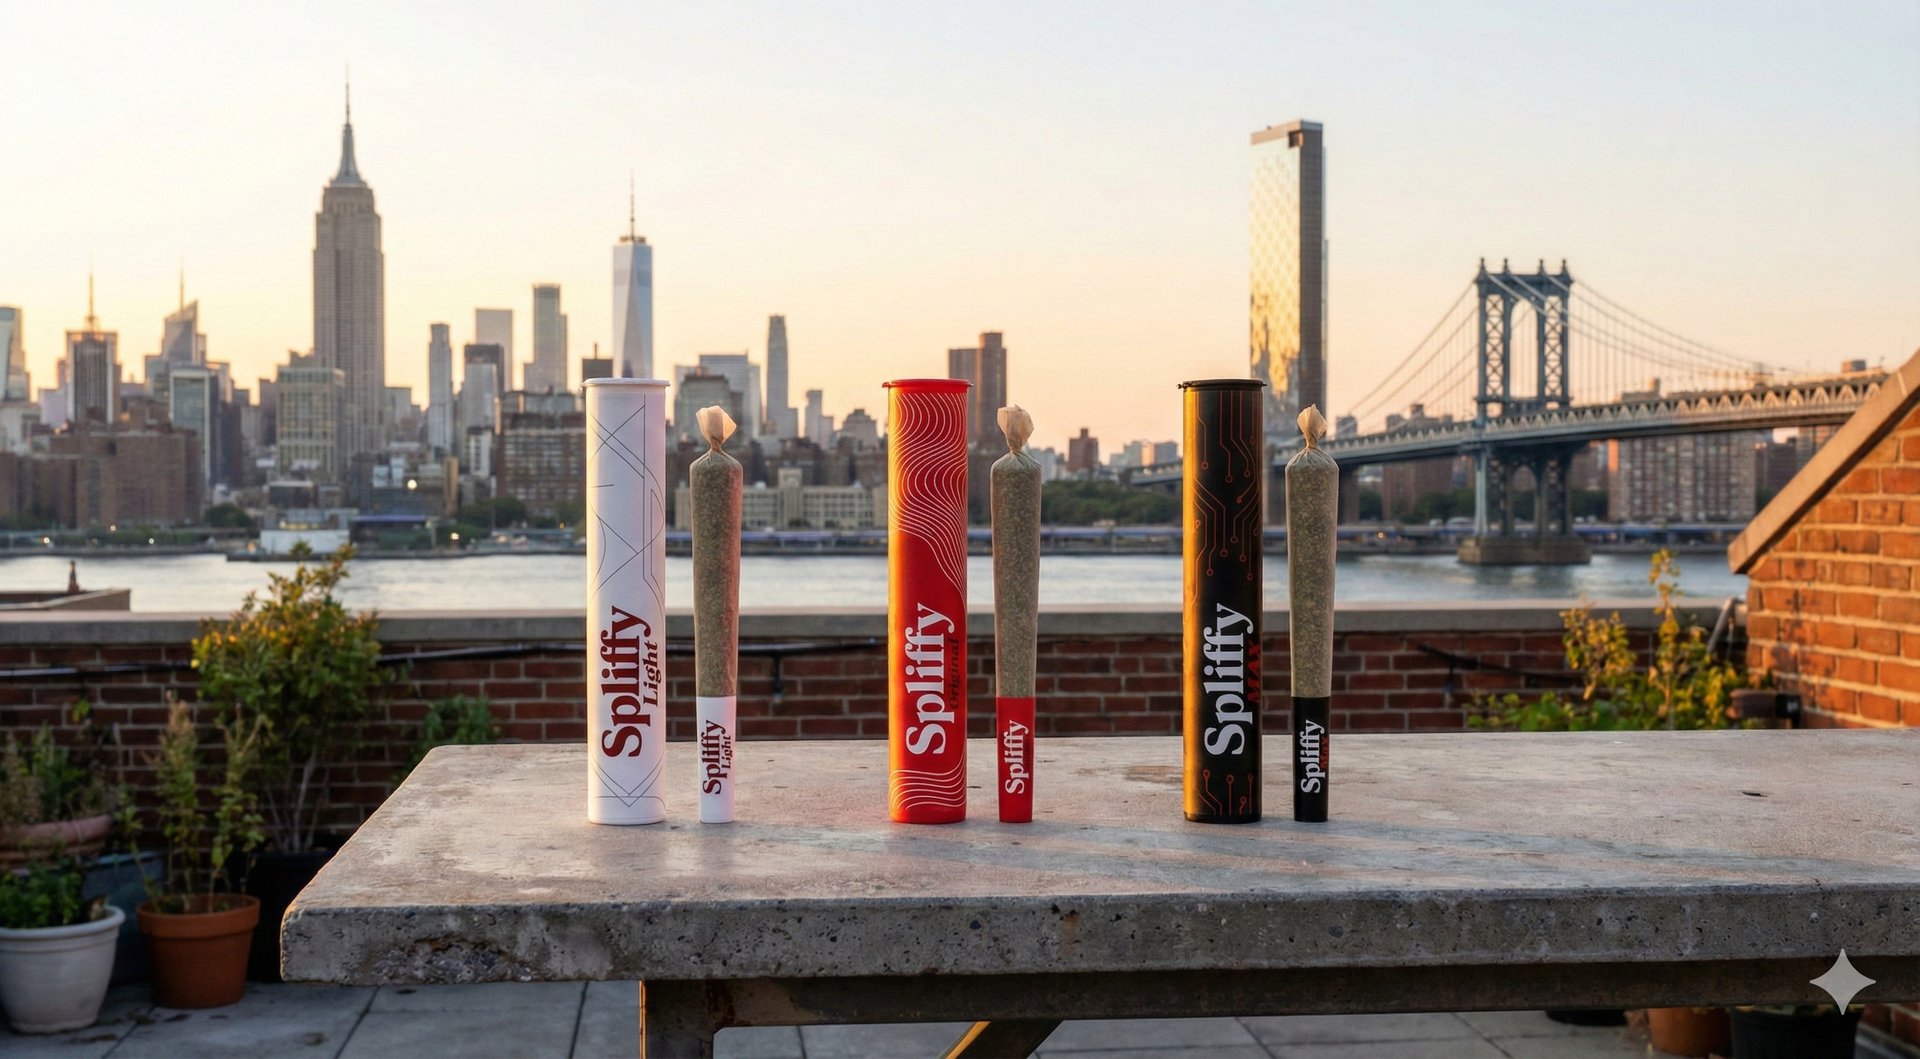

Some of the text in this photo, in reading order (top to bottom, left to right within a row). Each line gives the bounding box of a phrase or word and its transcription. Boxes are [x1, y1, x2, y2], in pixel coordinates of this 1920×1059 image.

[600, 605, 652, 757] Spliffy
[643, 640, 662, 707] Light
[904, 602, 955, 755] Spliffy
[1203, 602, 1254, 755] Spliffy
[700, 719, 728, 795] Spliffy
[1003, 719, 1029, 794] Spliffy
[1299, 719, 1326, 794] Spliffy
